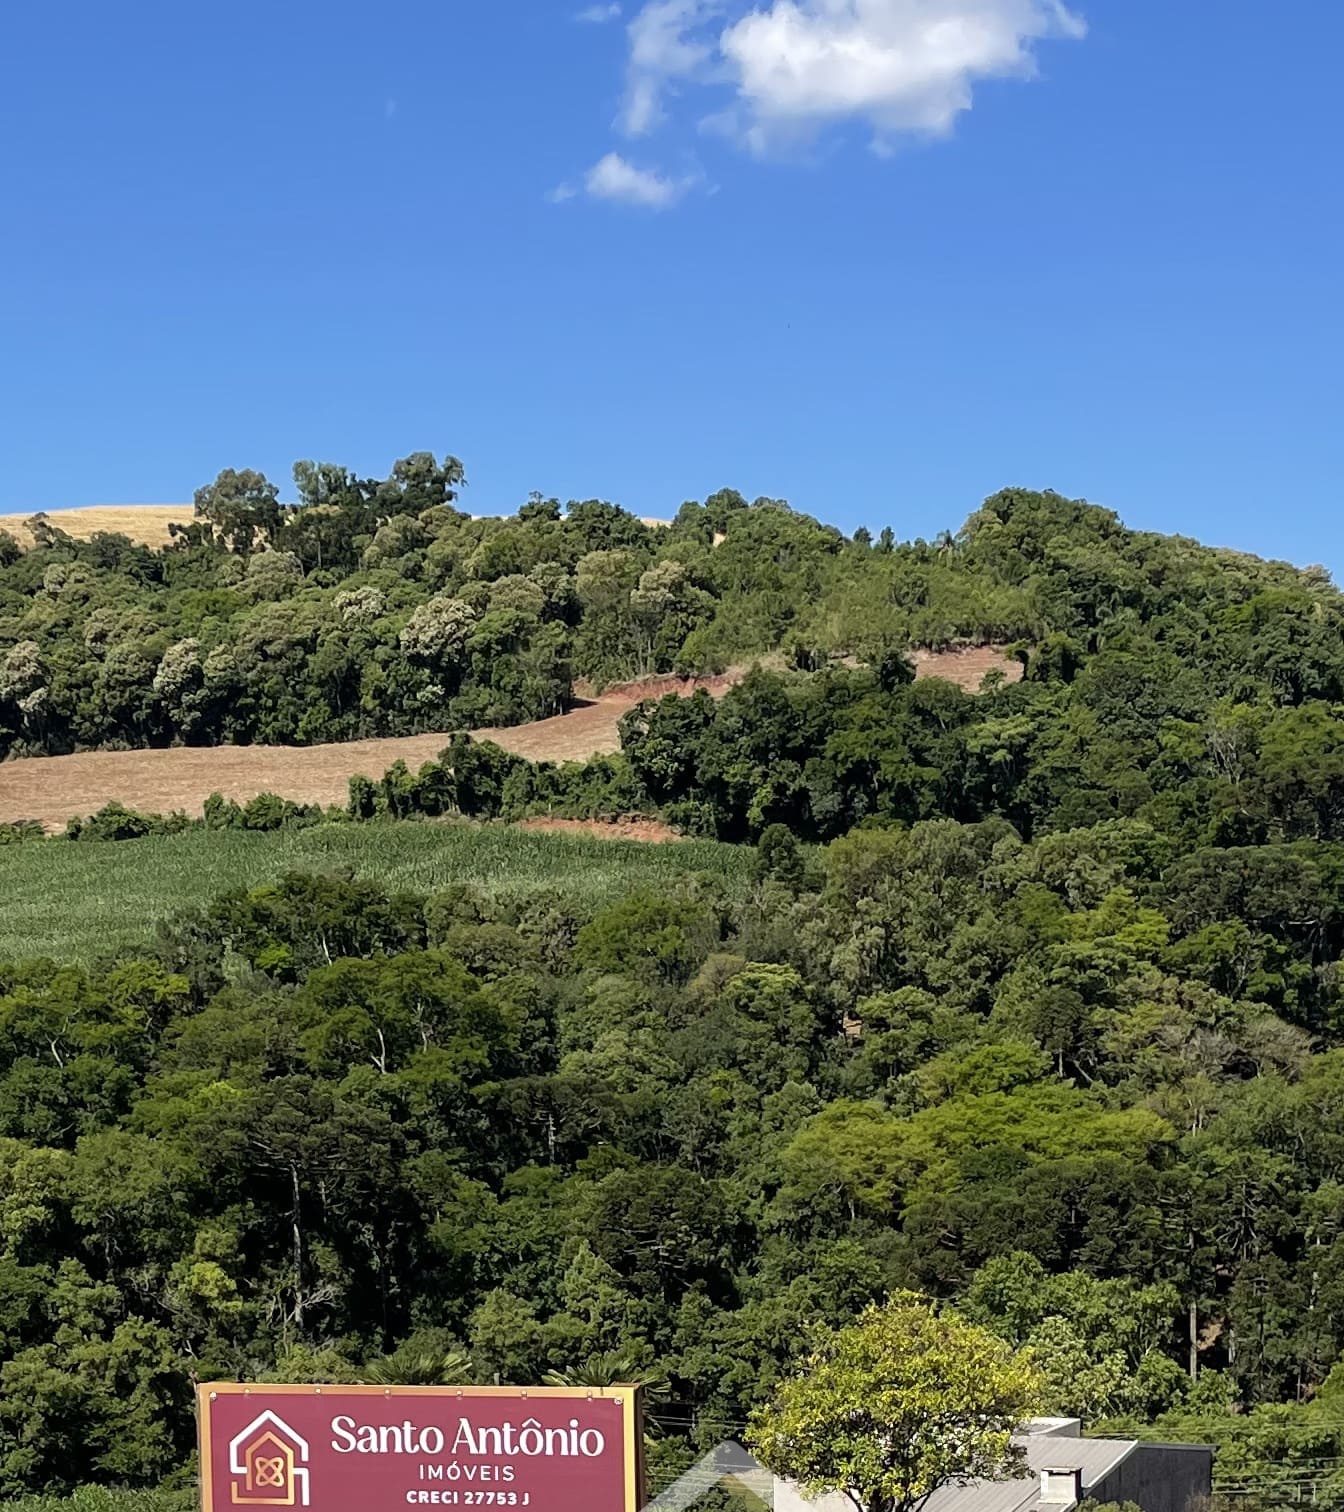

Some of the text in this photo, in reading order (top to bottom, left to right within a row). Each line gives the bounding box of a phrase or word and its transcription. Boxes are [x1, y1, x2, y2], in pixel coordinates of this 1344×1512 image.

[330, 1415, 605, 1457] Santo Antônio
[418, 1460, 516, 1482] IMÓVEIS
[406, 1490, 530, 1506] CRECI 27753 J
